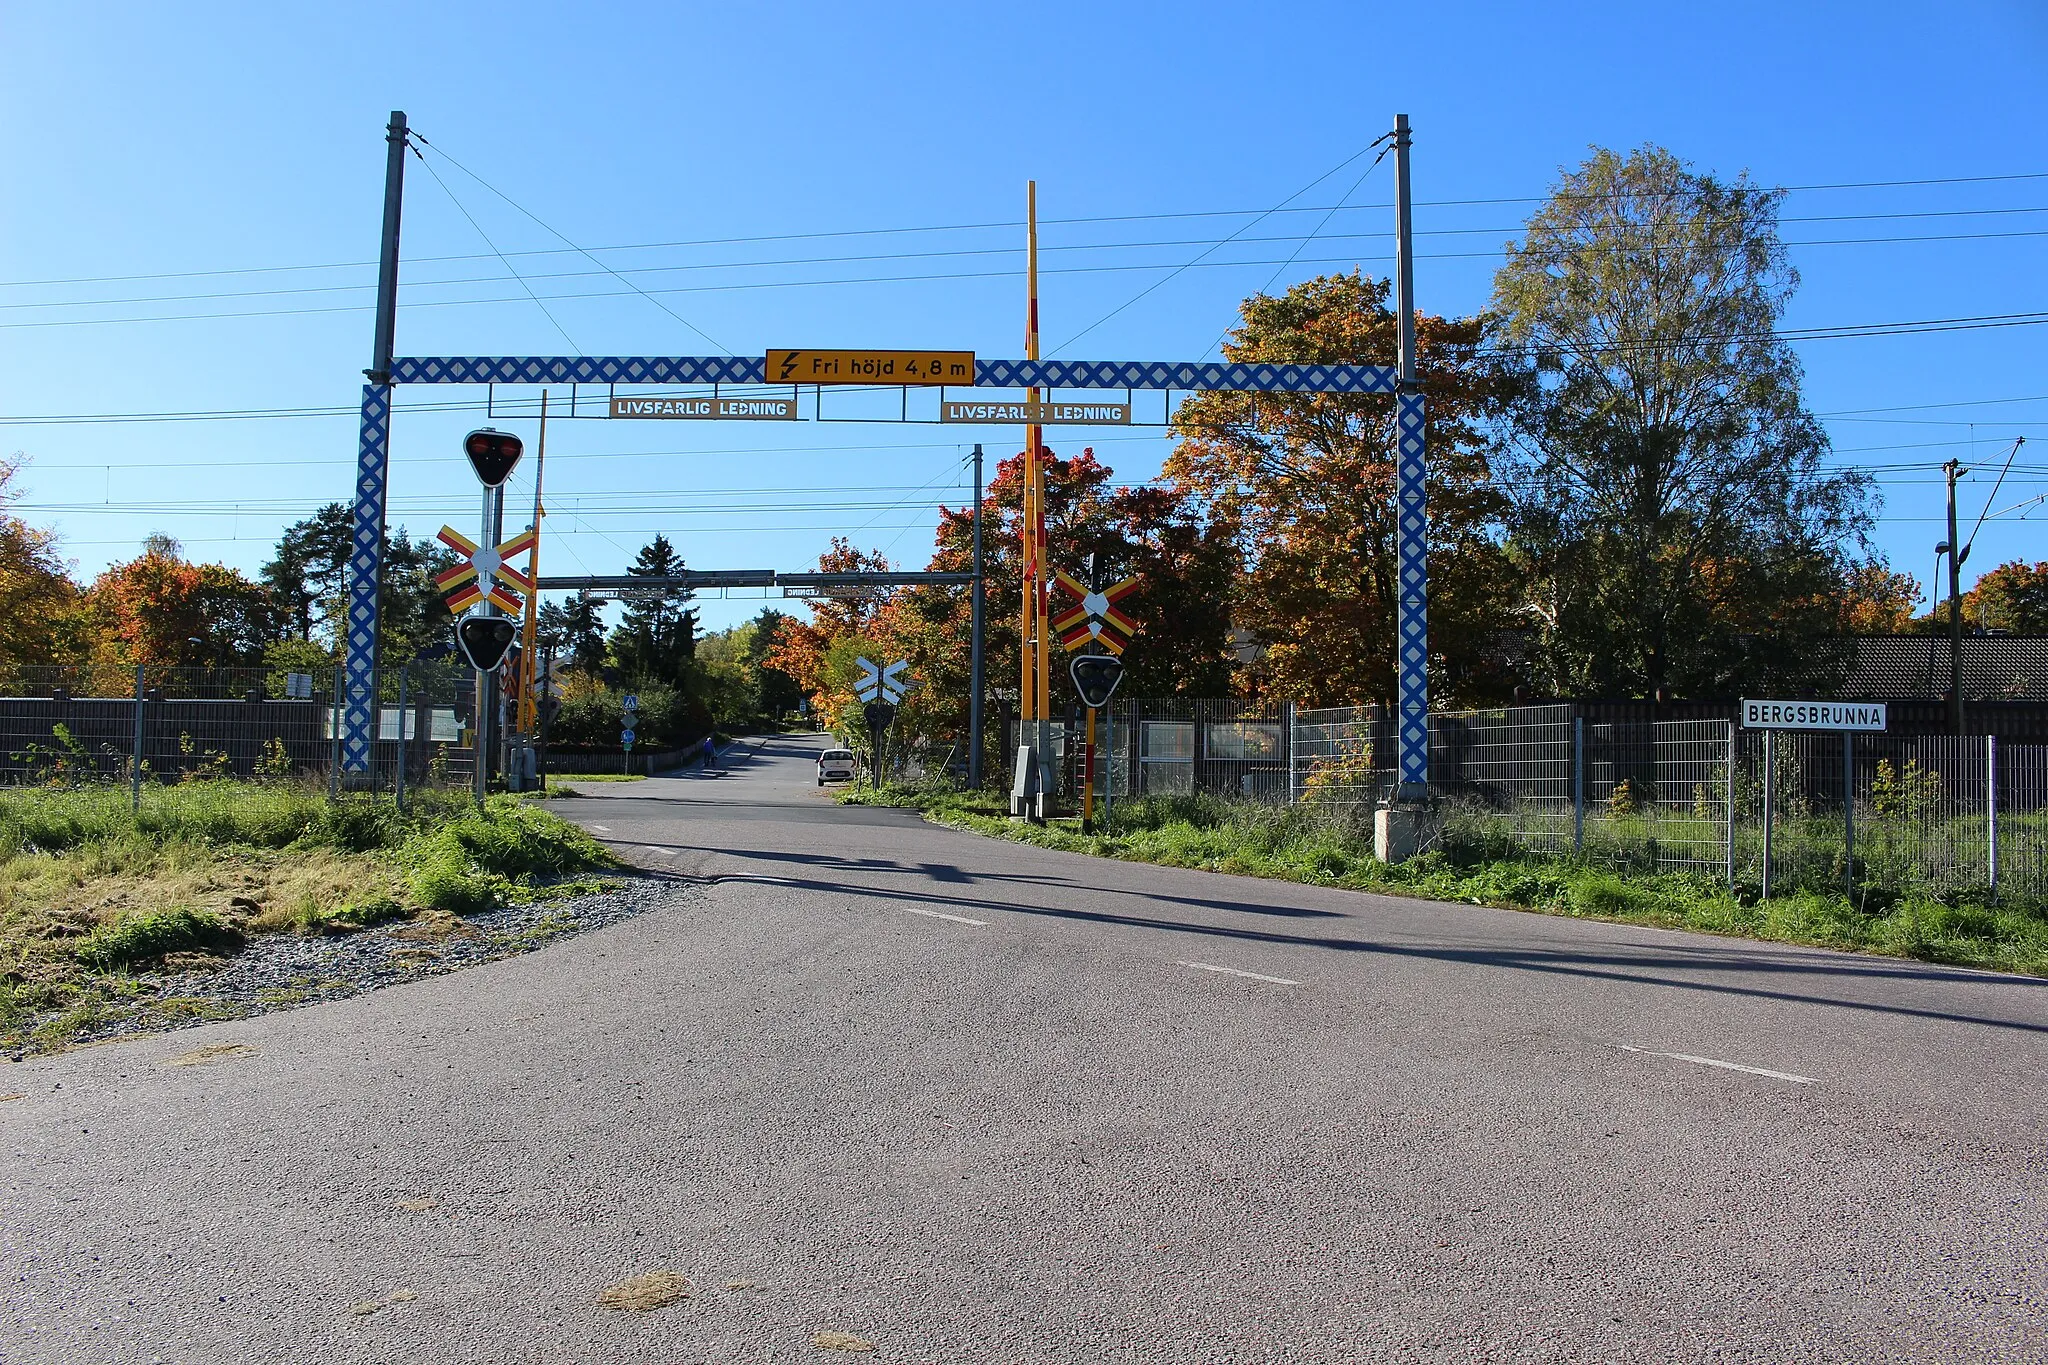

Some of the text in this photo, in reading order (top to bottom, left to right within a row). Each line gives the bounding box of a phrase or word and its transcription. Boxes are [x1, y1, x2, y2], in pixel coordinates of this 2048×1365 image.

[813, 358, 966, 379] Fri höjd 4,8 m
[617, 401, 787, 416] LIVSFARLIG LEDNING
[950, 405, 1122, 420] LIVSFARL LEDNING
[1749, 704, 1881, 725] BERGSBRUNNA
